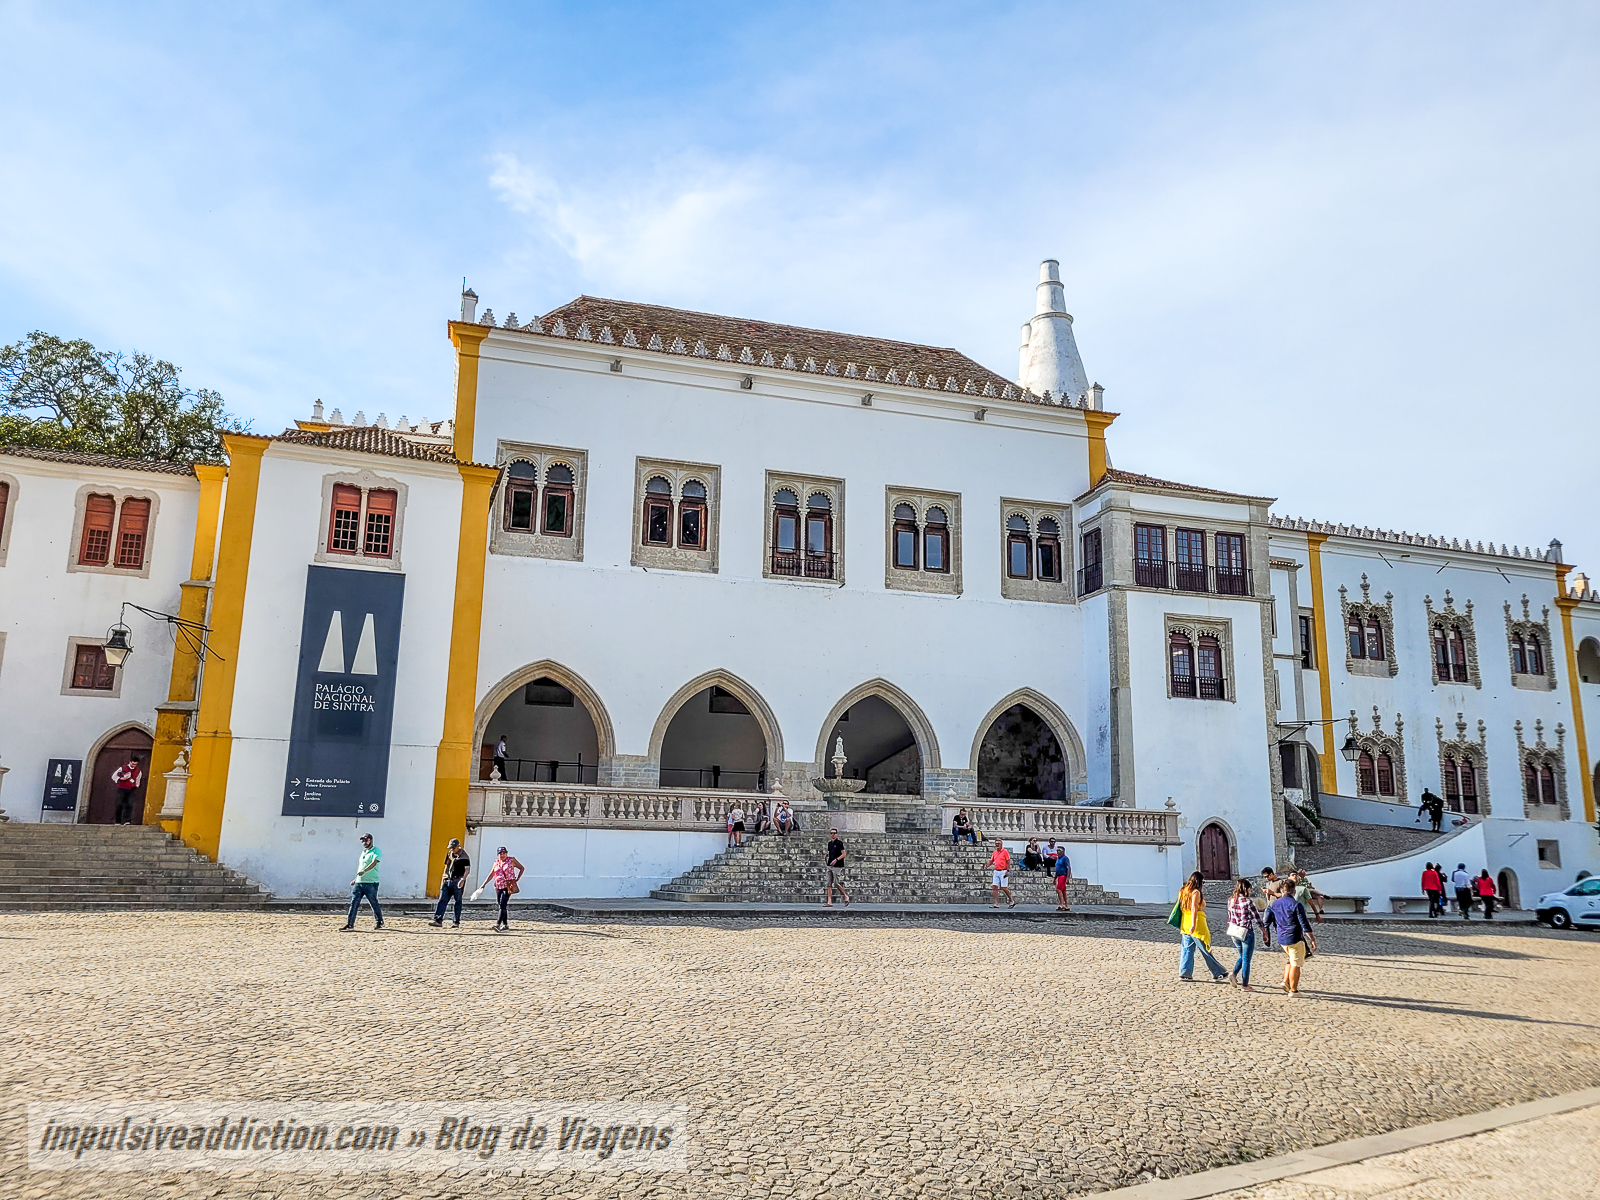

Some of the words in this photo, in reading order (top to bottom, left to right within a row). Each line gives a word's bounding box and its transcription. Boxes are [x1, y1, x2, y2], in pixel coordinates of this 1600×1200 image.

[315, 683, 365, 694] PALÁCIO
[314, 692, 376, 704] NACIONAL
[314, 701, 330, 710] DE
[332, 701, 375, 712] SINTRA
